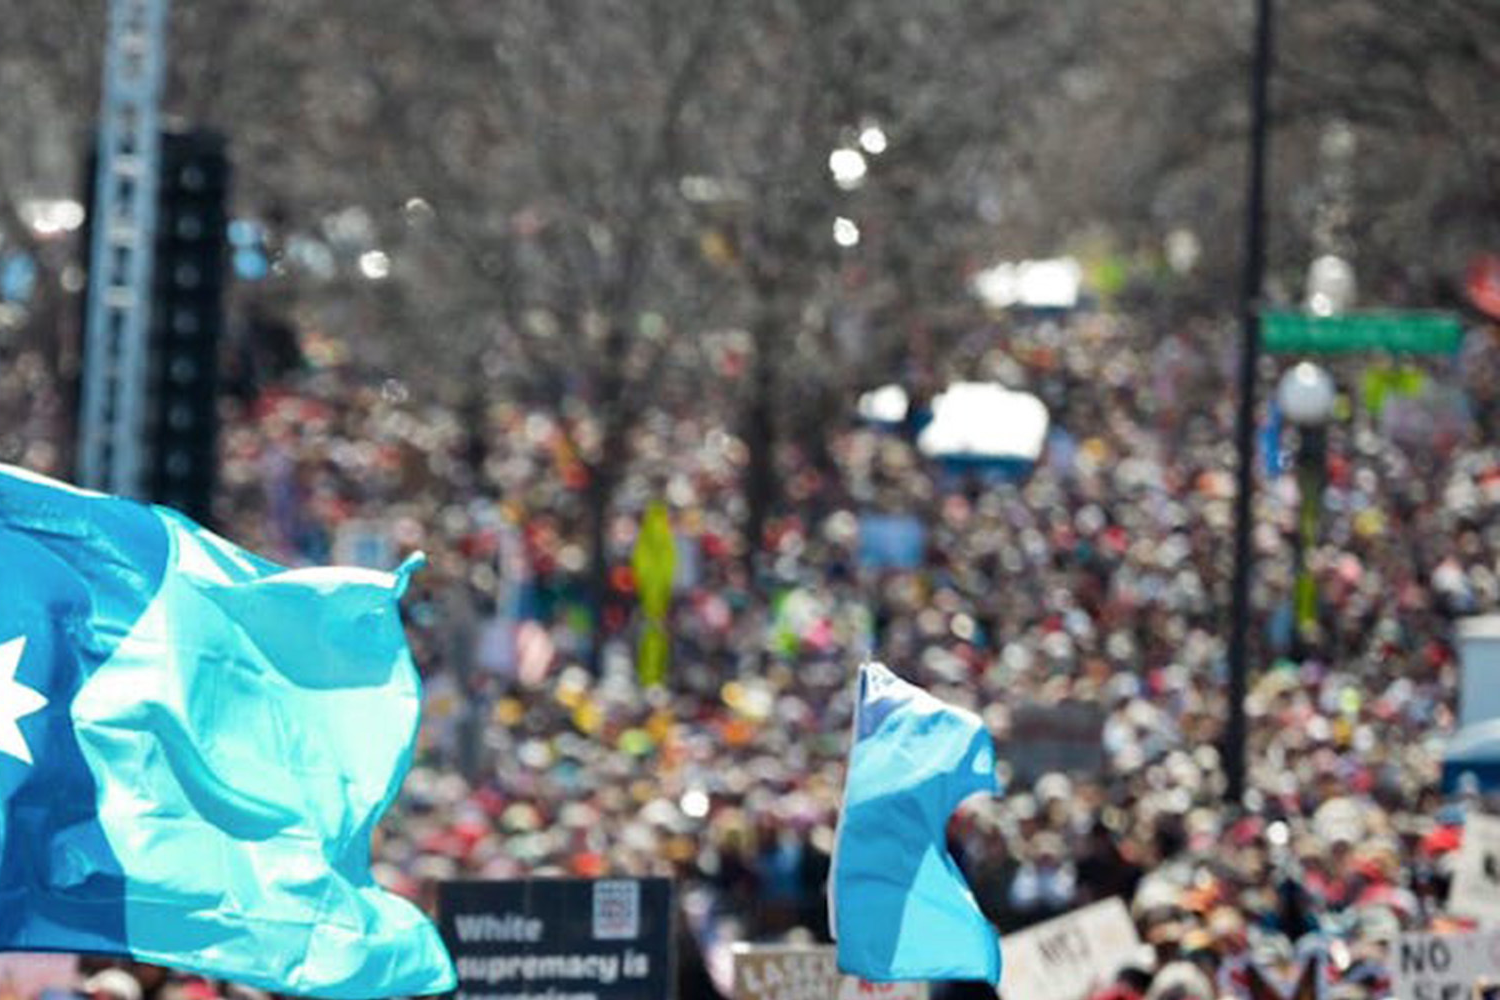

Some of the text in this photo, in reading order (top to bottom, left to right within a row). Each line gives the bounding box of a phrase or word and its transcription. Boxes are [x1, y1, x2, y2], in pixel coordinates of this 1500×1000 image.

[454, 912, 544, 943] White
[455, 947, 650, 984] supremacy is
[1402, 937, 1451, 973] NO
